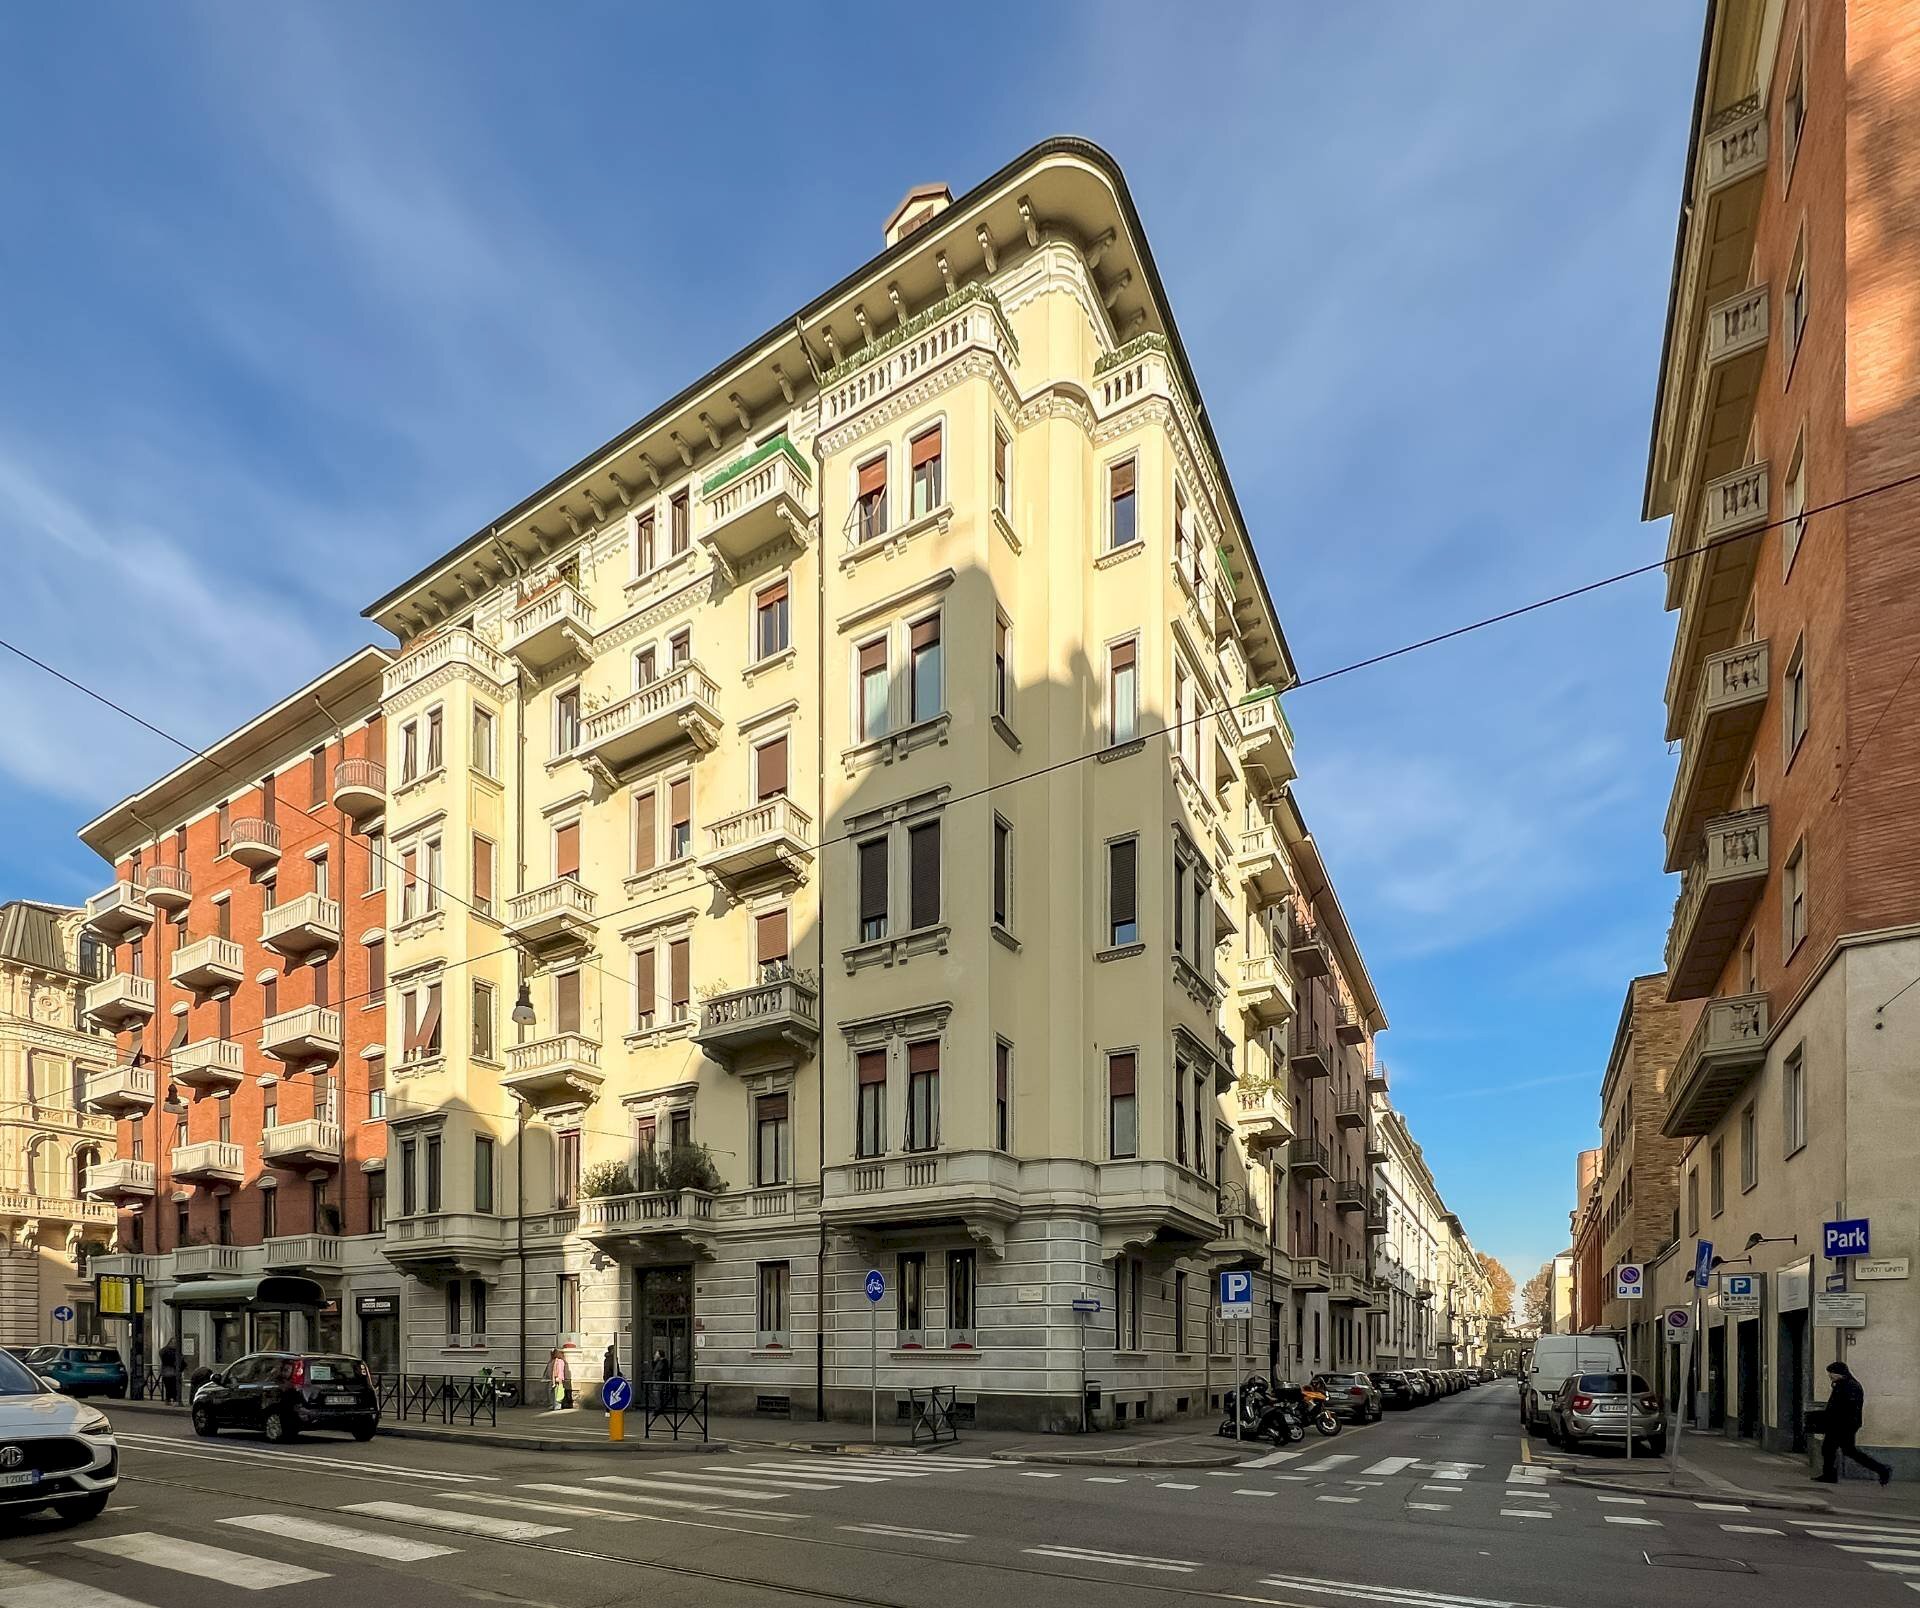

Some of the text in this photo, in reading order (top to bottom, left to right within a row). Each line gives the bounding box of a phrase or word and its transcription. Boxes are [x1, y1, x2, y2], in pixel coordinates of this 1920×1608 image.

[1826, 1227, 1866, 1249] Park
[1228, 1274, 1247, 1300] P
[1734, 1280, 1746, 1292] P
[0, 1448, 22, 1465] MG
